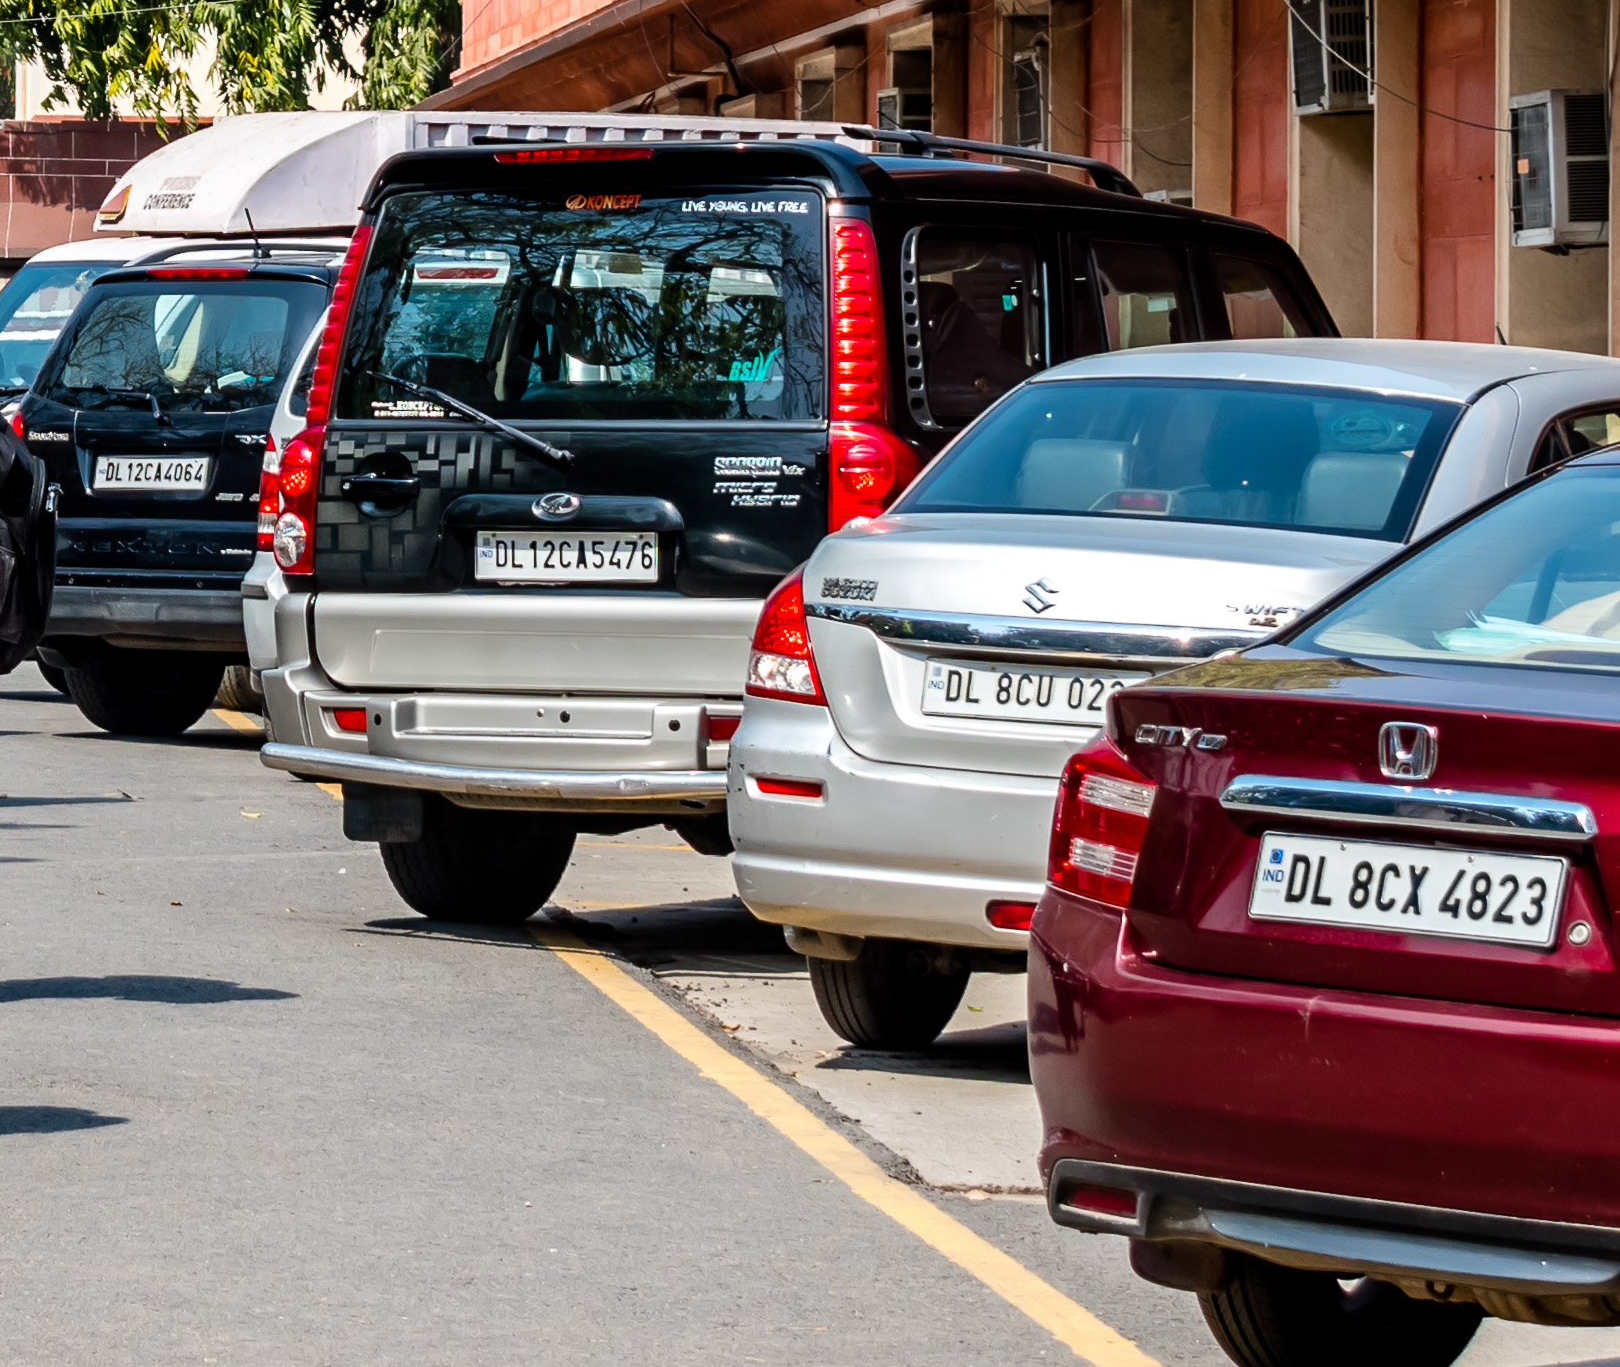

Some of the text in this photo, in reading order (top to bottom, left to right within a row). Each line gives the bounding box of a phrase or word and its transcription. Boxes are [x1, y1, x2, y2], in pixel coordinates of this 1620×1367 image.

[586, 194, 641, 210] KONCEPT
[681, 200, 706, 213] LIVE
[750, 202, 775, 213] LIVE
[777, 201, 809, 214] FREE
[495, 539, 654, 570] DL12CA5476
[945, 669, 1125, 712] DL 8CU 02
[1135, 724, 1203, 747] CITY
[1262, 868, 1285, 883] IND
[1284, 853, 1548, 926] DL 8CX 4823
